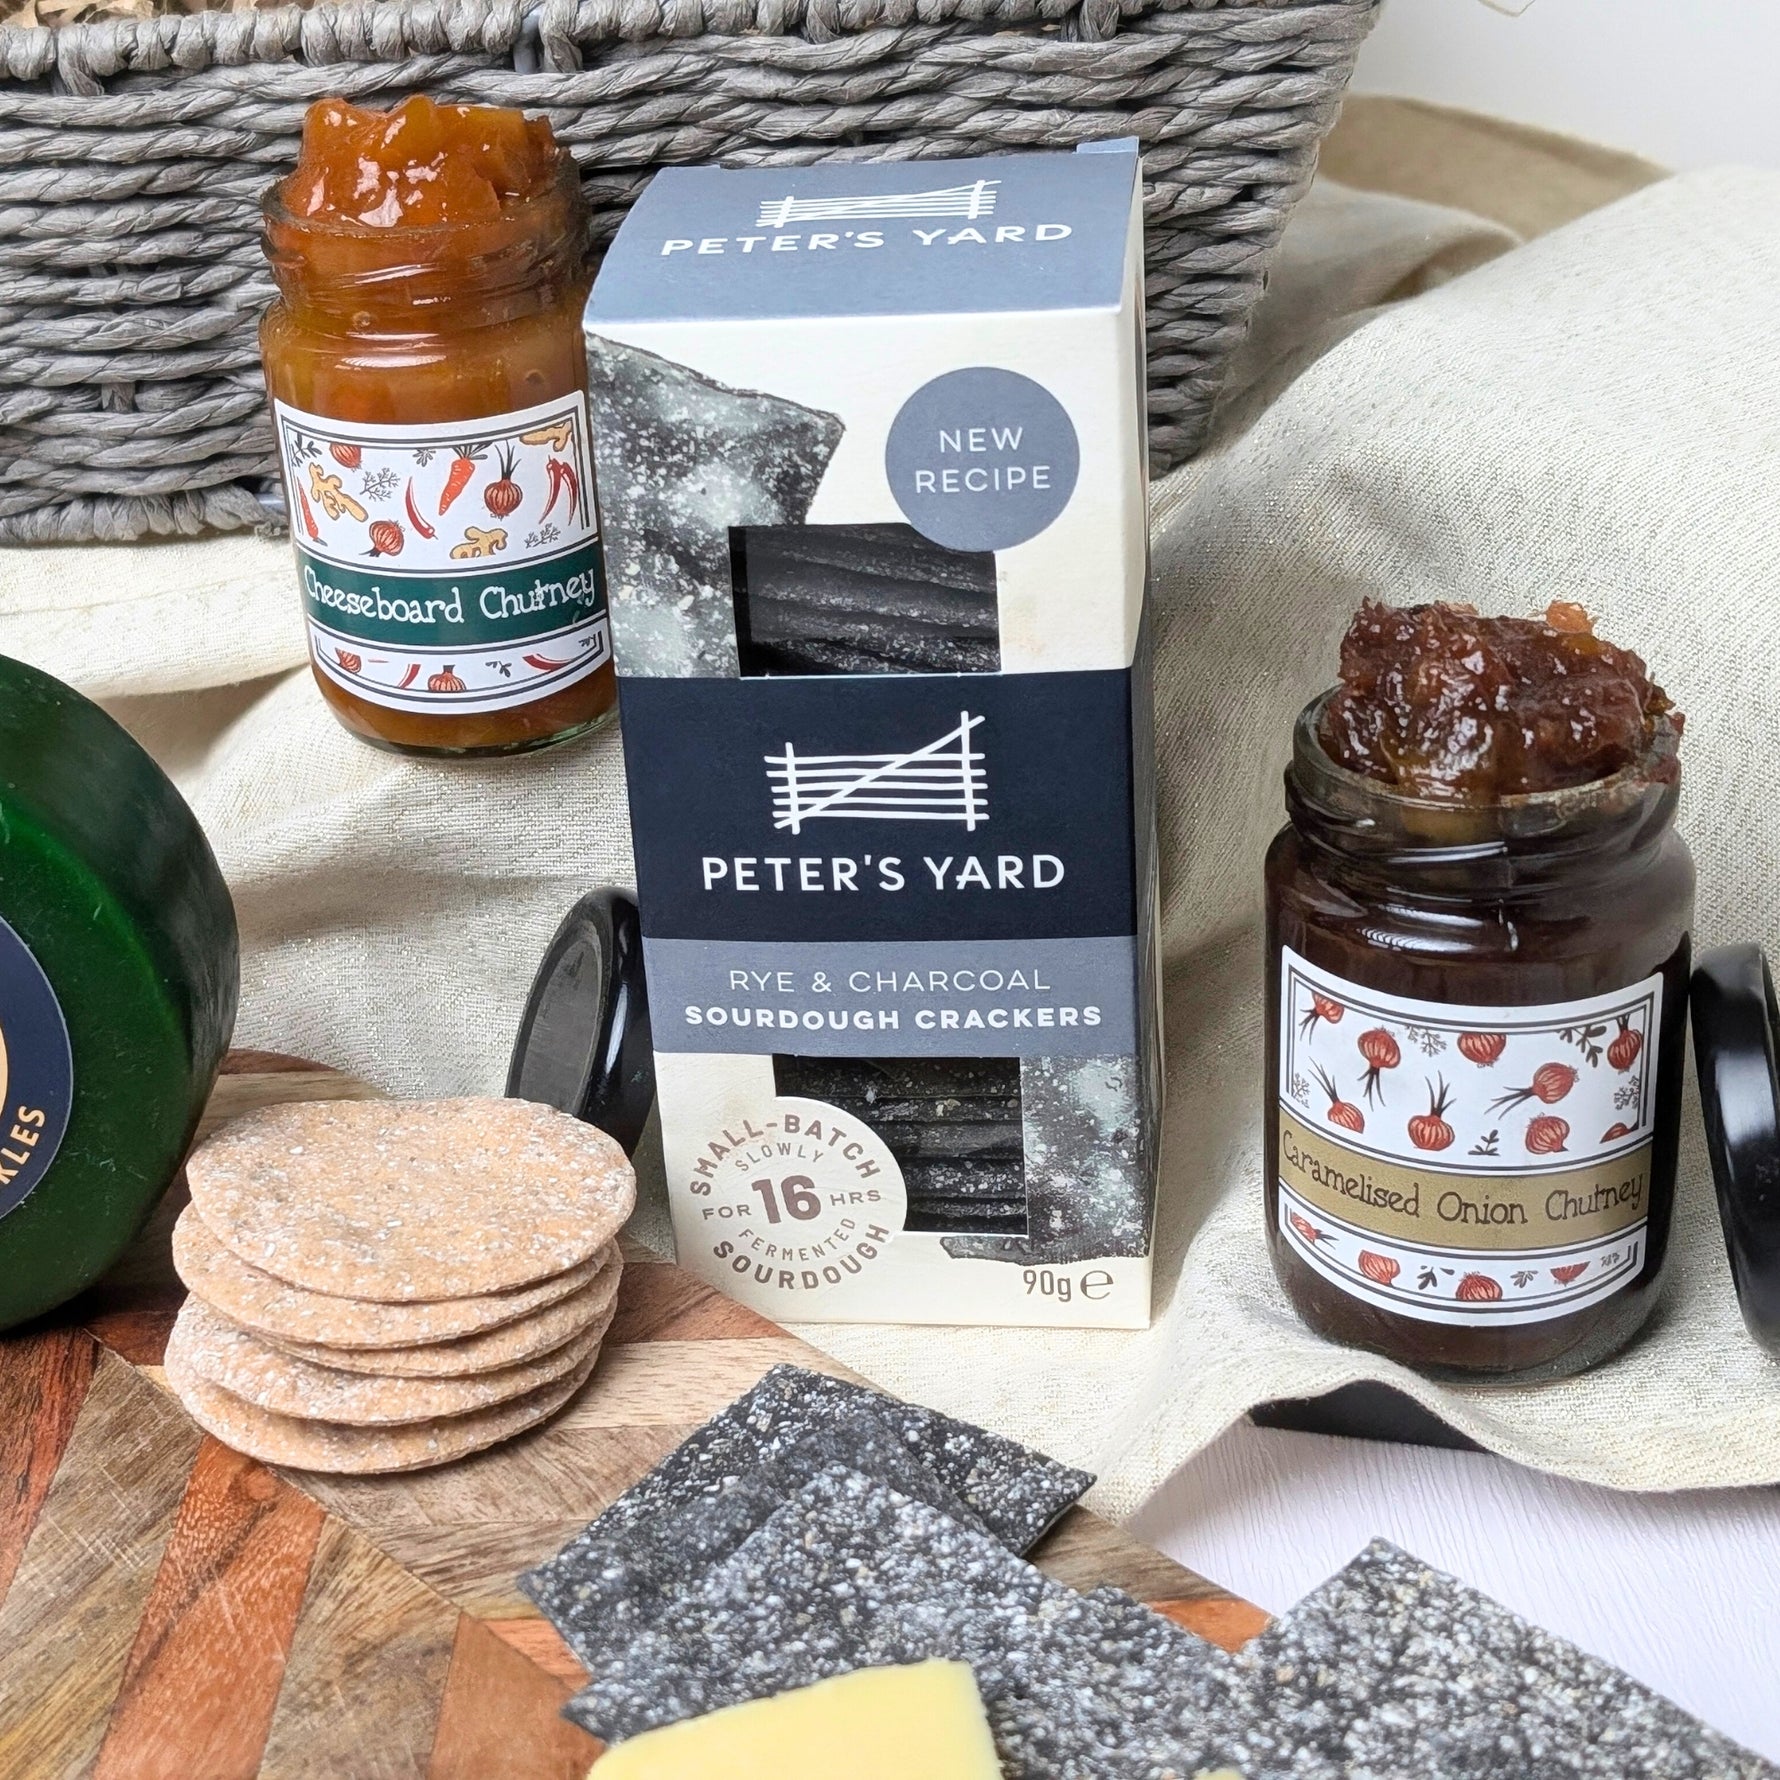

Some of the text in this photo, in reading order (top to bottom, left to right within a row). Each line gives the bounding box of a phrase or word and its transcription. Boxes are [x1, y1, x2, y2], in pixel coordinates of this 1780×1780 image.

[661, 223, 1073, 256] PETER'S YARD
[939, 426, 1023, 453] NEW
[915, 465, 1051, 494] RECIPE
[303, 563, 596, 624] Cheeseboard Chutney
[702, 854, 1066, 892] PETER'S YARD
[729, 968, 1051, 993] RYE & CHARCOAL
[684, 1005, 1102, 1031] SOURDOUGH CRACKERS
[690, 1114, 881, 1196] SMALL-BATCH
[735, 1142, 824, 1172] SLOWLY
[1283, 1129, 1644, 1224] Caramelised Onion Chutney
[702, 1174, 882, 1225] FOR 16 HRS
[713, 1224, 889, 1290] SOURDOUGH
[738, 1218, 856, 1262] FERMENTED
